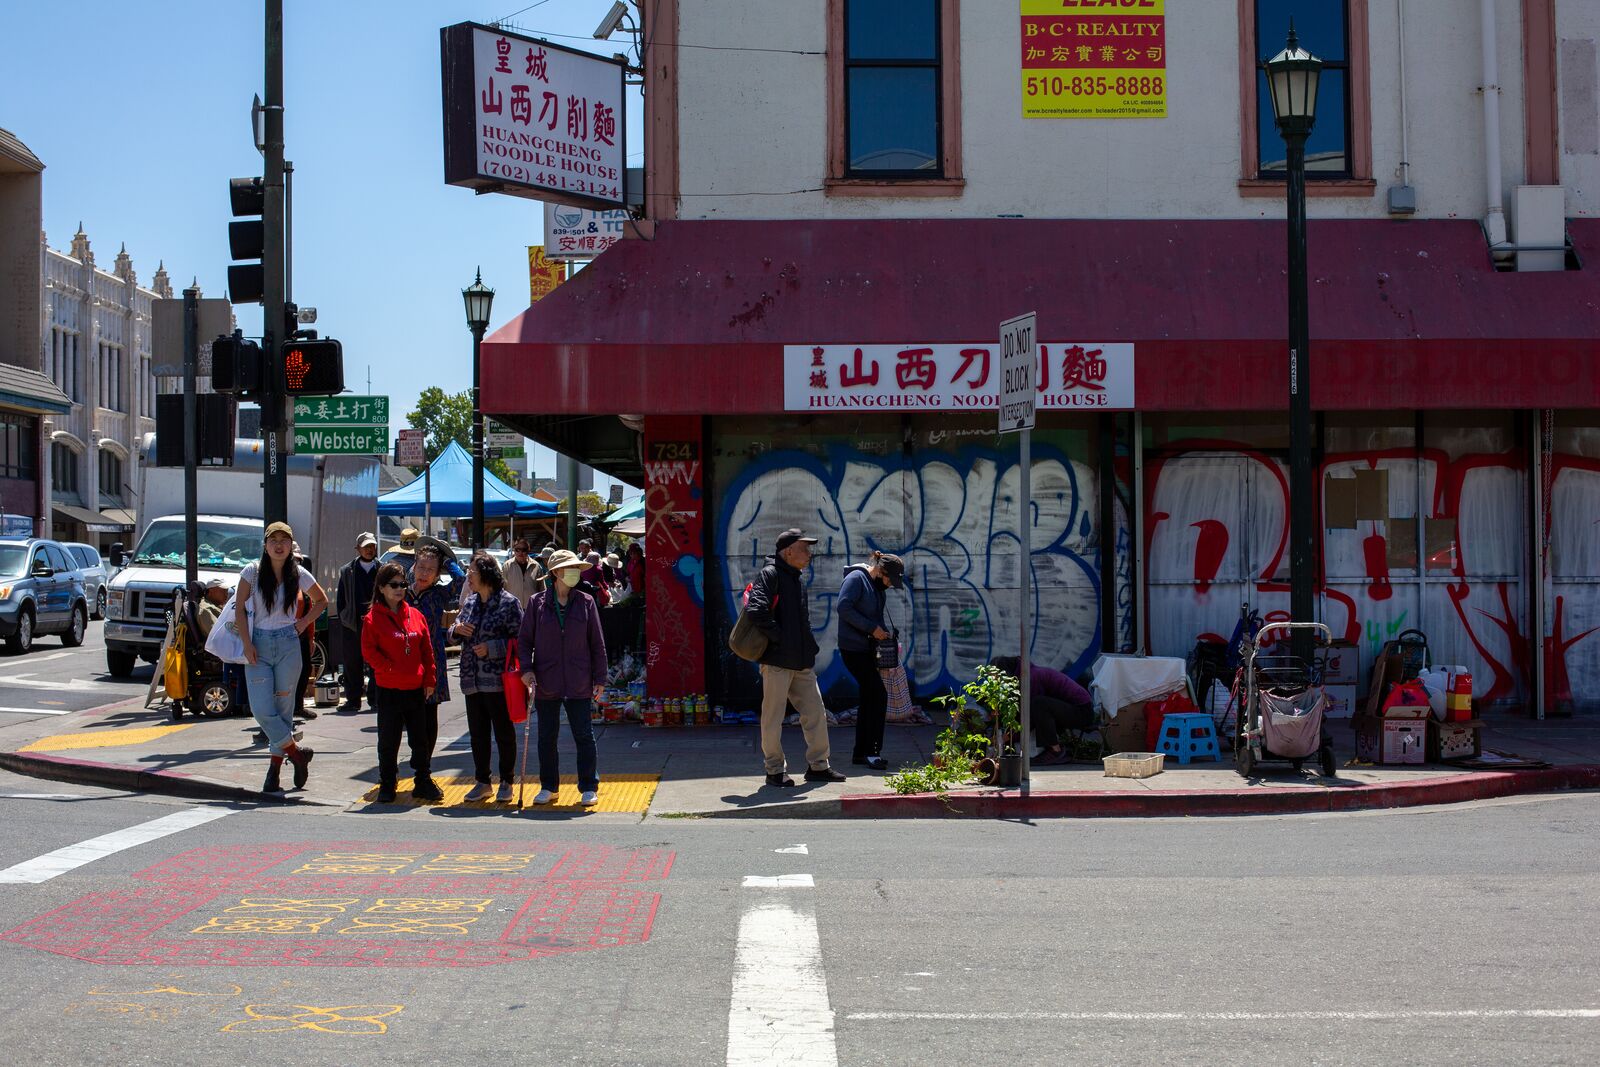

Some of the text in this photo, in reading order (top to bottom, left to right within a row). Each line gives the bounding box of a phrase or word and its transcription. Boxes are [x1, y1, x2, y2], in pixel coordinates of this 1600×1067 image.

[495, 36, 549, 83] 皇城
[1026, 45, 1162, 62] 加宏實業公司
[1027, 76, 1163, 96] 510-835-8888
[482, 76, 615, 146] 山西刀削麵
[483, 125, 602, 162] HUANGCHENG
[483, 141, 618, 180] NOODLE HOUSE
[484, 160, 618, 199] (702) 481-3124
[587, 222, 598, 233] &
[1004, 327, 1031, 359] DO NOT
[1005, 364, 1029, 394] BLOCK
[809, 394, 941, 407] HUANGCHENG
[1043, 394, 1108, 406] HOUSE
[310, 432, 372, 450] Webster
[655, 444, 692, 459] 734
